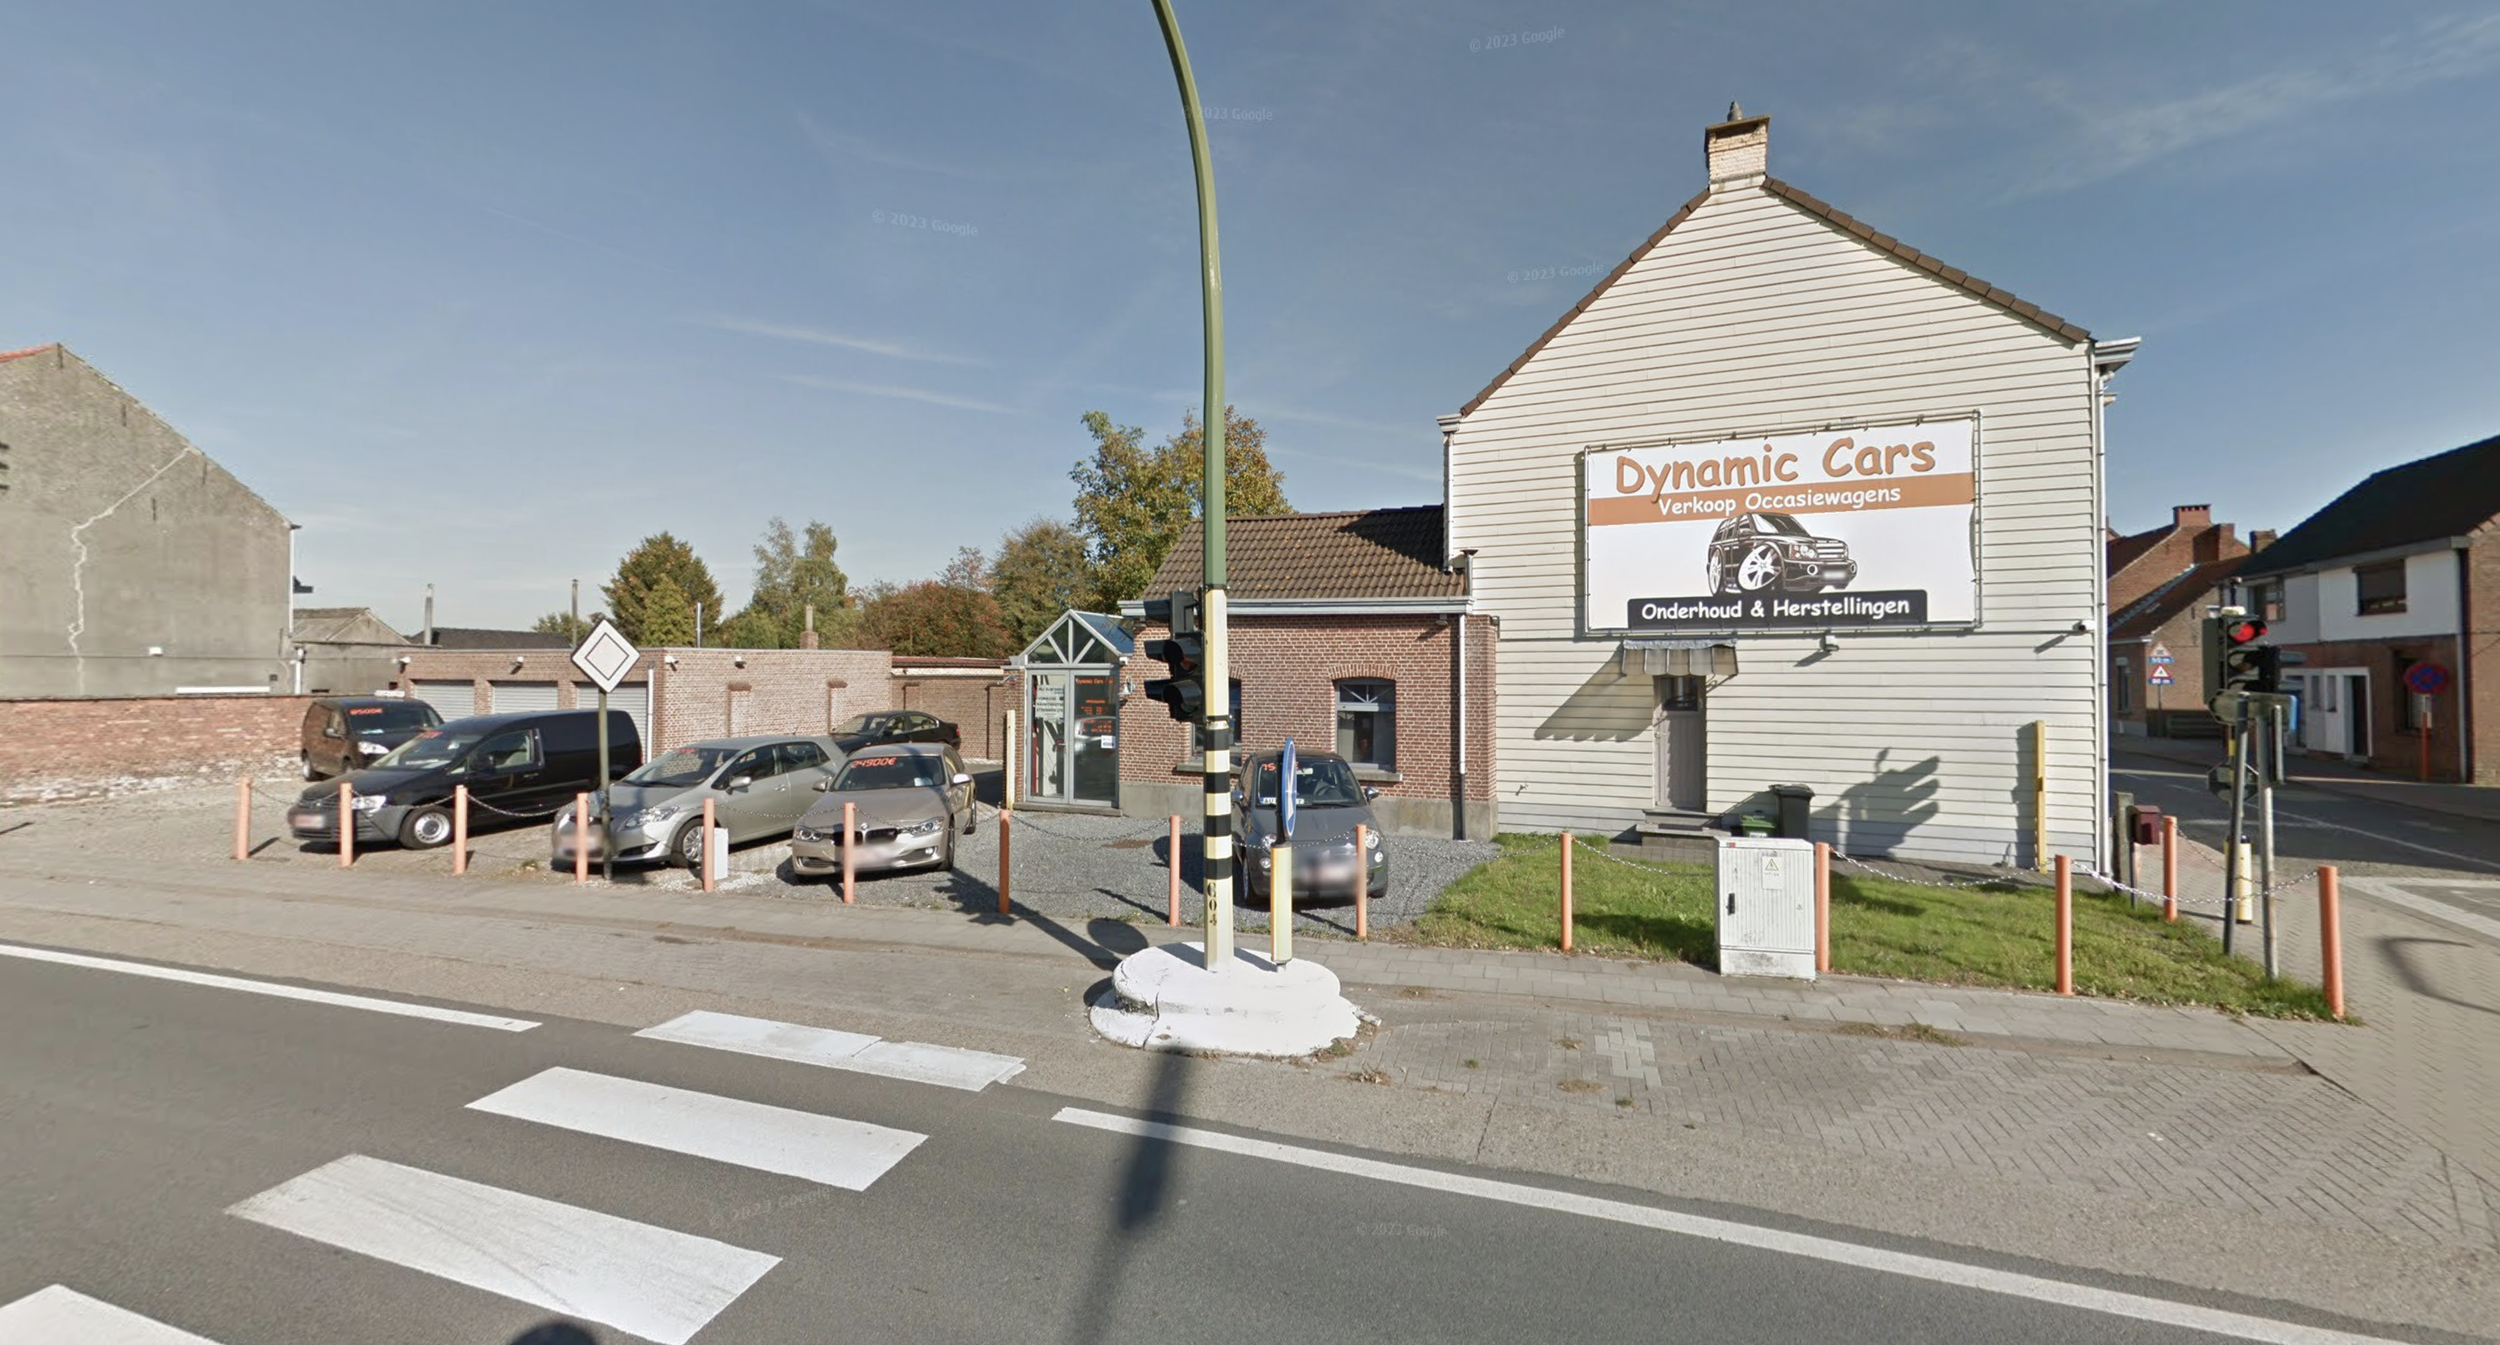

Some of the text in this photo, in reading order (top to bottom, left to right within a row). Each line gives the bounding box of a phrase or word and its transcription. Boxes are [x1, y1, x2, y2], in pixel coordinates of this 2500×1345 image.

[1616, 436, 1936, 504] Dynamic Cars
[1658, 485, 1901, 518] Verkoop Occasiewagens
[1641, 594, 1910, 621] Onderhoud & Herstellingen
[851, 757, 897, 769] 24900€
